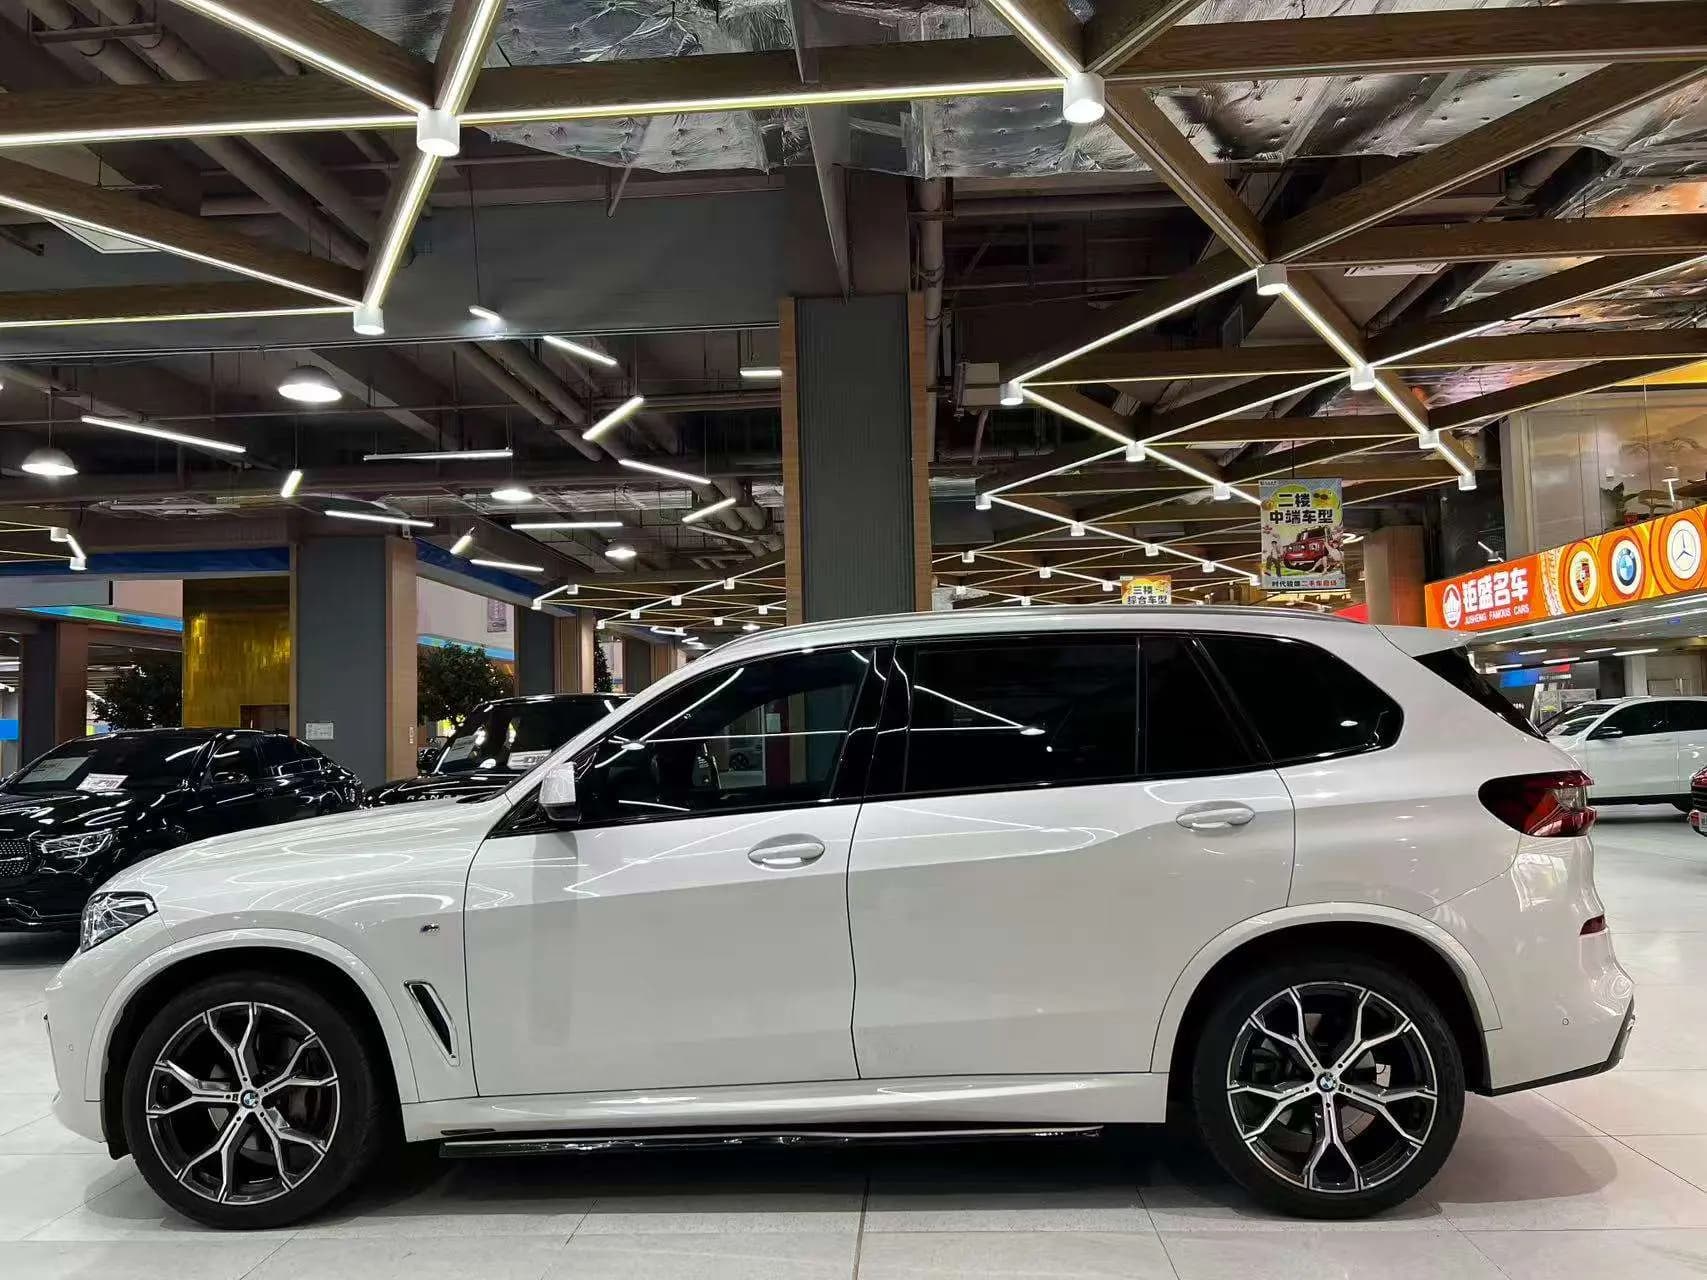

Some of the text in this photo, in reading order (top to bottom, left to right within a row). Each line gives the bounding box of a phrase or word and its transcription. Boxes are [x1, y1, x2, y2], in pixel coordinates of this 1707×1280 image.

[1278, 493, 1310, 507] 二楼
[1270, 509, 1333, 524] 中端车型
[1489, 608, 1511, 620] FAMOUS
[1513, 604, 1530, 616] CARS
